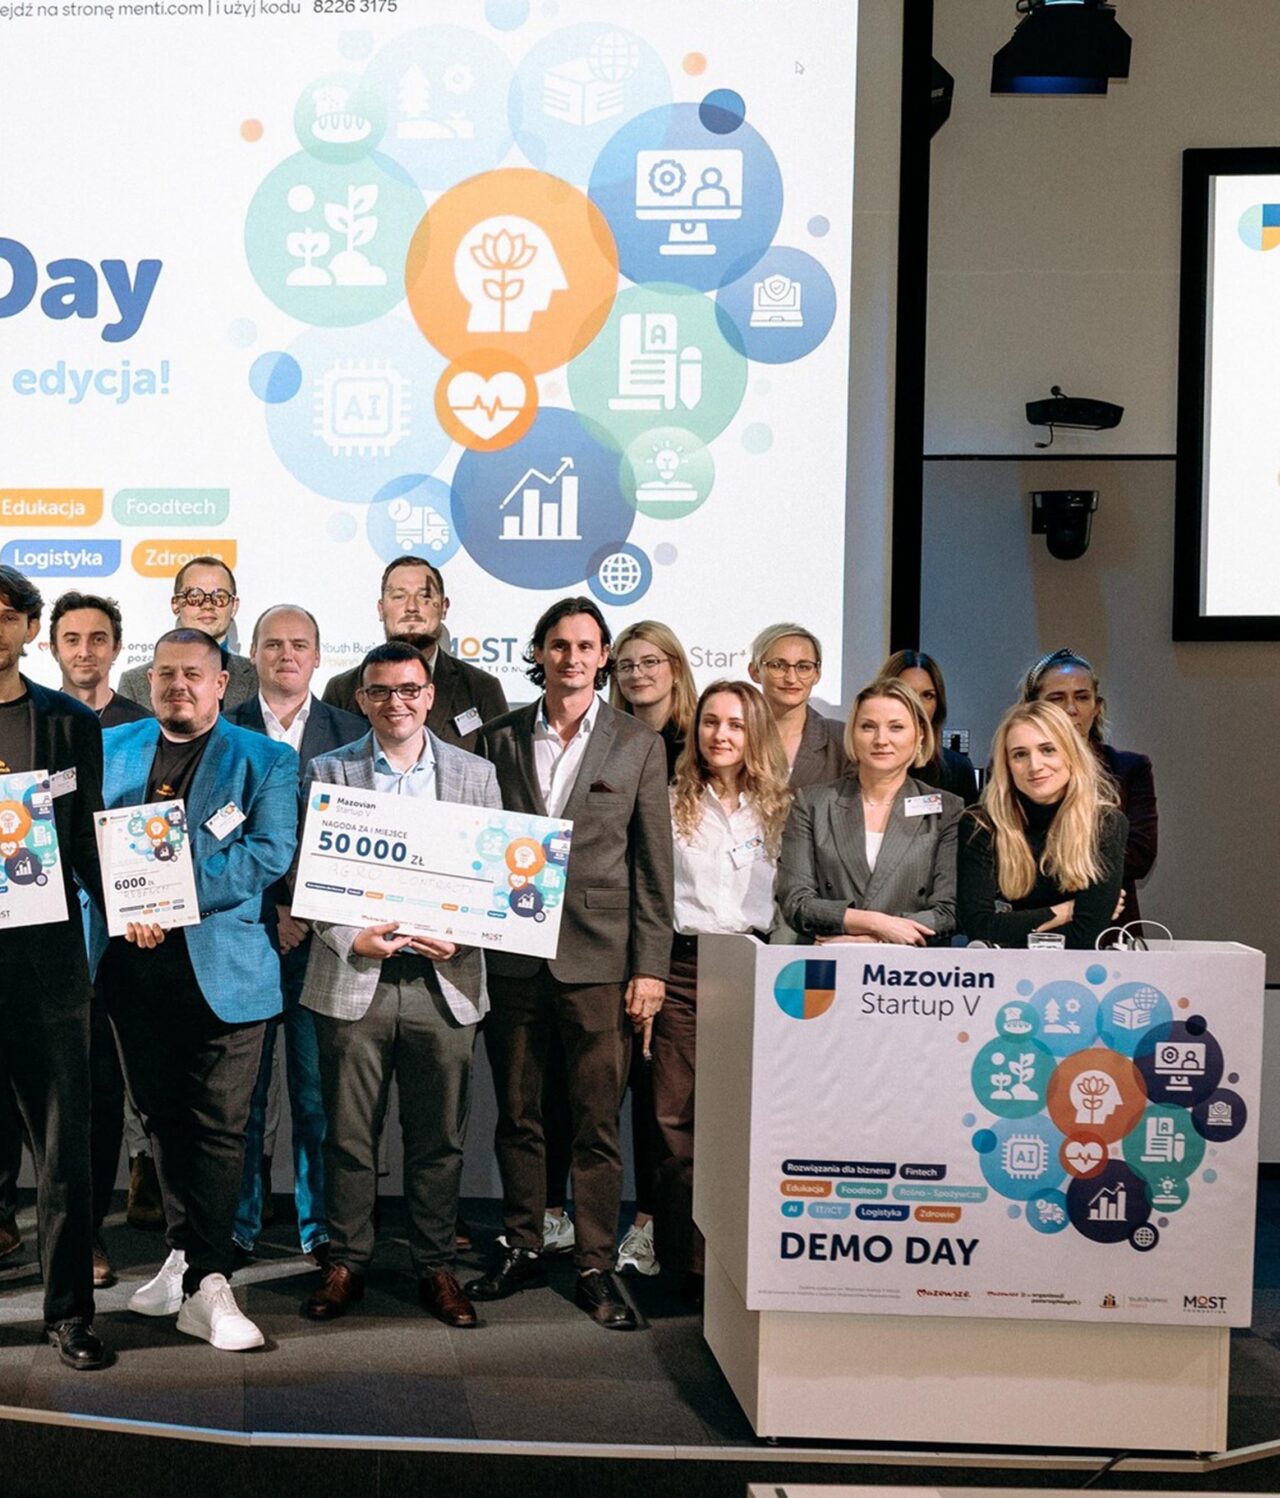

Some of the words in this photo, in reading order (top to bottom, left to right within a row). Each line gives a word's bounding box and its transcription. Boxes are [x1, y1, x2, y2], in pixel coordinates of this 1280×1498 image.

[37, 5, 58, 17] na
[62, 4, 114, 19] stronę
[118, 1, 204, 16] menti.com
[223, 0, 256, 18] użyj
[260, 0, 301, 14] kodu
[313, 0, 356, 13] 8226
[359, 0, 398, 13] 3175
[12, 360, 171, 405] edycja!
[1, 498, 86, 519] Edukacja
[127, 498, 216, 515] Foodtech
[14, 549, 103, 570] Logistyka
[336, 797, 377, 811] Mazovian
[322, 819, 358, 832] NAGODA
[359, 825, 370, 834] ZA
[374, 828, 408, 840] MIEJSCE
[318, 831, 351, 854] 50
[356, 836, 407, 863] 000
[411, 855, 425, 867] ZŁ
[114, 877, 147, 891] 6000
[862, 964, 995, 989] Mazovian
[861, 992, 955, 1020] Startup
[963, 996, 981, 1017] V
[787, 1163, 841, 1176] Rozwiązania
[842, 1166, 856, 1174] dla
[857, 1166, 891, 1176] biznesu
[905, 1168, 938, 1177] Fintech
[786, 1184, 825, 1195] Edukacja
[841, 1187, 882, 1196] Foodtech
[900, 1188, 924, 1197] Rolno
[788, 1205, 798, 1213] AI
[862, 1208, 902, 1218] Logistyka
[920, 1210, 956, 1219] Zdrowie
[780, 1232, 893, 1263] DEMO
[905, 1236, 980, 1266] DAY
[1183, 1295, 1227, 1309] MOST
